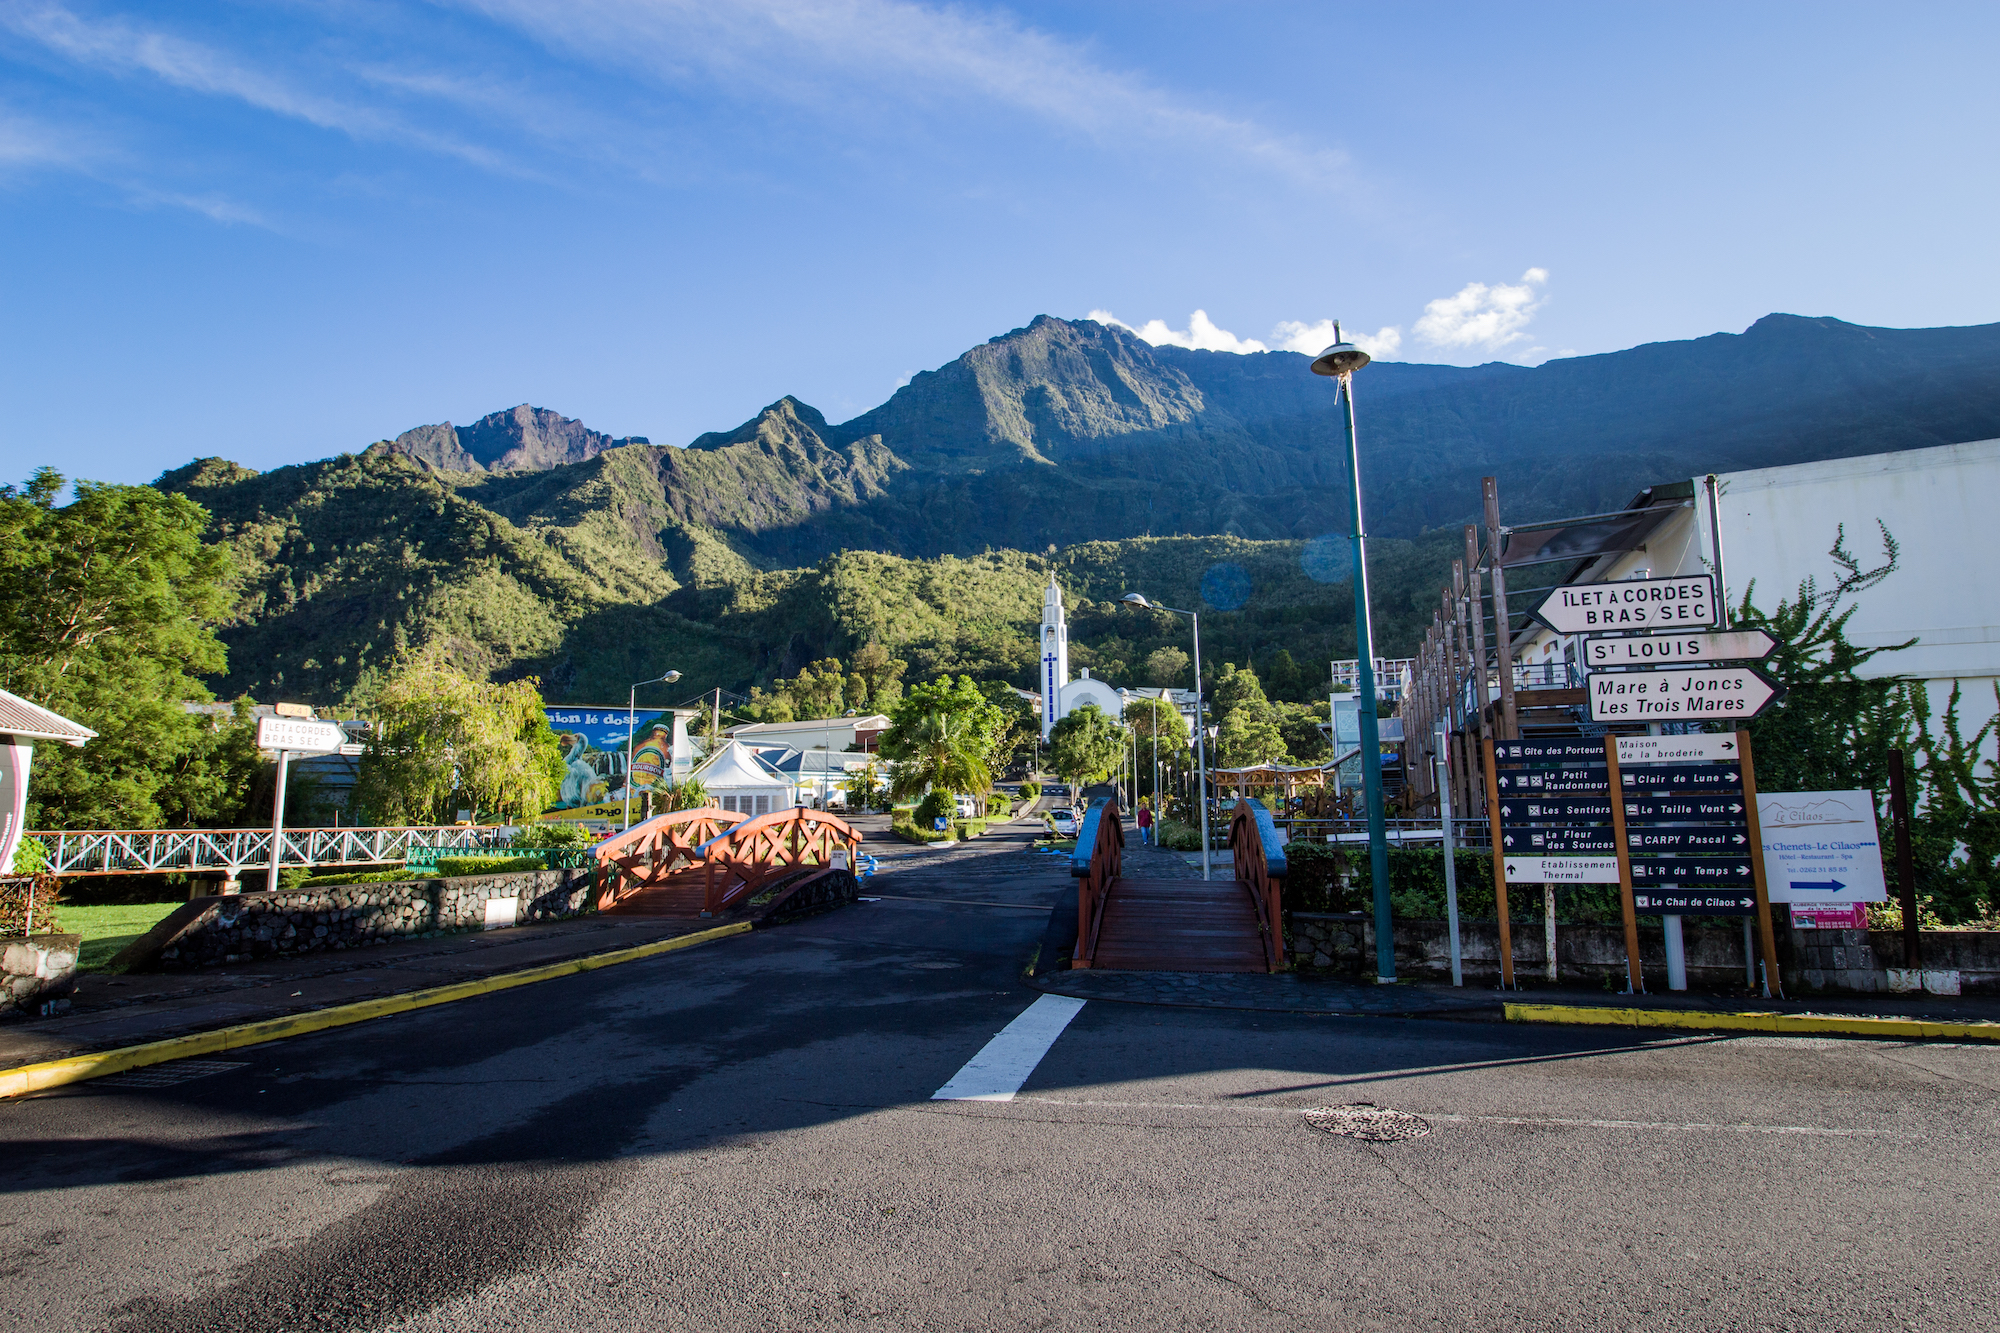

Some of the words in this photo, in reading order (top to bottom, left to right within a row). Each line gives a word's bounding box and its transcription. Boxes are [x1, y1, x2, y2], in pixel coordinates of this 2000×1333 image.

[1562, 590, 1603, 607] ÎLET
[1623, 584, 1704, 603] CORDES
[1586, 607, 1647, 625] BRAS
[1660, 604, 1706, 620] SEC
[1628, 640, 1700, 658] LOUIS
[1597, 680, 1647, 696] Mare
[1660, 678, 1669, 693] à
[1681, 676, 1744, 692] Joncs
[280, 705, 286, 714] D
[290, 706, 309, 715] 241
[1599, 700, 1629, 715] Les
[1636, 698, 1681, 713] Trois
[1686, 696, 1745, 712] Mares
[548, 712, 581, 724] nion
[585, 714, 599, 725] lé
[603, 713, 640, 726] doss
[295, 725, 332, 737] CORDES
[264, 734, 294, 744] BRAS
[300, 736, 320, 746] SEC
[1619, 740, 1658, 749] Maison
[1546, 746, 1562, 755] des
[1565, 745, 1604, 755] Porteurs
[1620, 750, 1633, 760] de
[1640, 750, 1650, 759] la
[1657, 748, 1704, 759] broderie
[632, 764, 662, 776] BOURBON
[1544, 771, 1556, 780] Le
[1562, 770, 1588, 780] Petit
[1638, 773, 1666, 784] Clair
[1673, 773, 1687, 783] de
[1693, 773, 1720, 783] Lune
[1545, 781, 1608, 790] Randonneur
[1542, 806, 1561, 815] Les
[1566, 804, 1611, 814] Sentiers
[1641, 805, 1653, 815] Le
[1660, 804, 1692, 814] Taille
[1699, 804, 1725, 813] Vent
[1774, 811, 1785, 823] Le
[1789, 810, 1823, 821] Cilaos
[1546, 831, 1558, 840] La
[1563, 829, 1592, 839] Fleur
[1644, 835, 1681, 845] CARPY
[1688, 834, 1726, 844] Pascal
[1547, 841, 1565, 850] des
[1572, 840, 1615, 849] Sources
[1541, 860, 1616, 869] Etablissement
[1543, 871, 1584, 879] Thermal
[1673, 866, 1687, 875] du
[1694, 866, 1729, 877] Temps
[1651, 897, 1663, 906] Le
[1665, 897, 1688, 906] Chai
[1690, 897, 1703, 906] de
[1705, 897, 1736, 907] Cilaos
